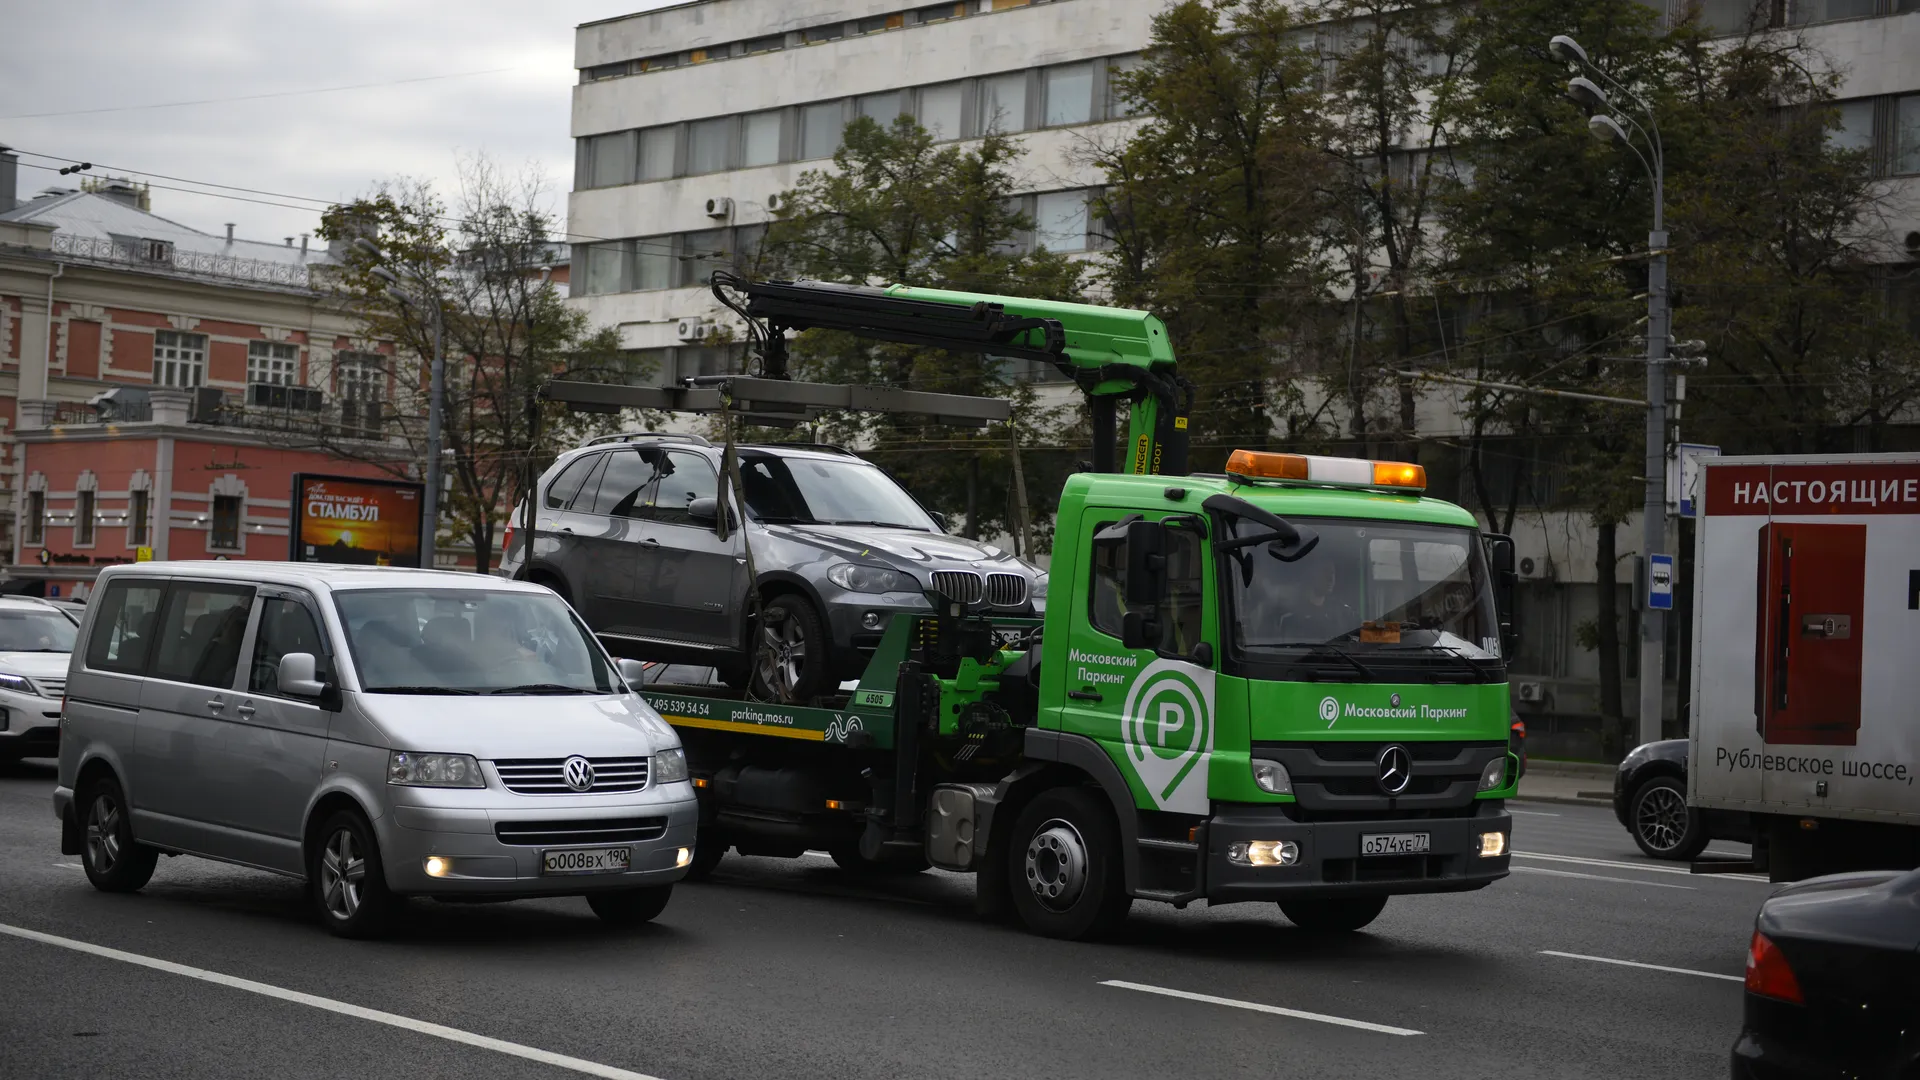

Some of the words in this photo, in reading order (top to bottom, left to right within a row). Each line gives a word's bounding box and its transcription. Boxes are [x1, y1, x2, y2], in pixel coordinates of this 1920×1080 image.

[1734, 479, 1918, 507] НАСТОЯЩИЕ
[308, 501, 379, 521] СТАМБУЛ
[1069, 648, 1137, 667] Московский
[1078, 667, 1125, 685] Паркинг
[653, 698, 669, 711] 495
[670, 700, 686, 713] 539
[687, 702, 697, 714] 54
[698, 703, 709, 716] 54
[865, 693, 884, 705] 6505
[731, 707, 793, 725] parking.mos.ru
[1344, 703, 1417, 718] Московский
[1420, 704, 1467, 722] Паркинг
[1157, 702, 1185, 747] P
[1716, 747, 1834, 775] Рублевское
[1842, 760, 1914, 786] шоссе,
[1415, 834, 1426, 847] 77
[607, 850, 626, 862] 190
